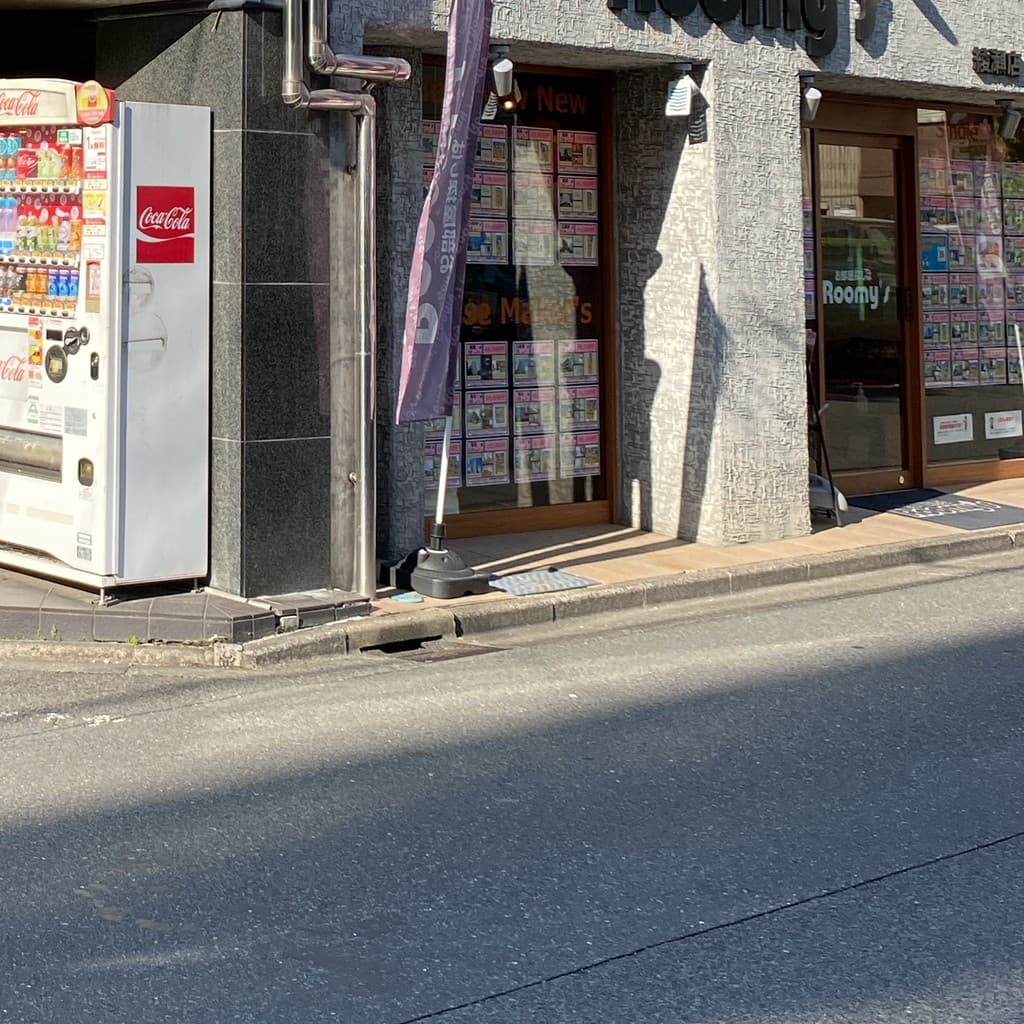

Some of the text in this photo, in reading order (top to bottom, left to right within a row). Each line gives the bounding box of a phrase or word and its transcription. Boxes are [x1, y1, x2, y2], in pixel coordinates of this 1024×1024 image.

[537, 84, 590, 115] New
[139, 206, 193, 230] Coca-Cola
[822, 279, 890, 310] Roomy's
